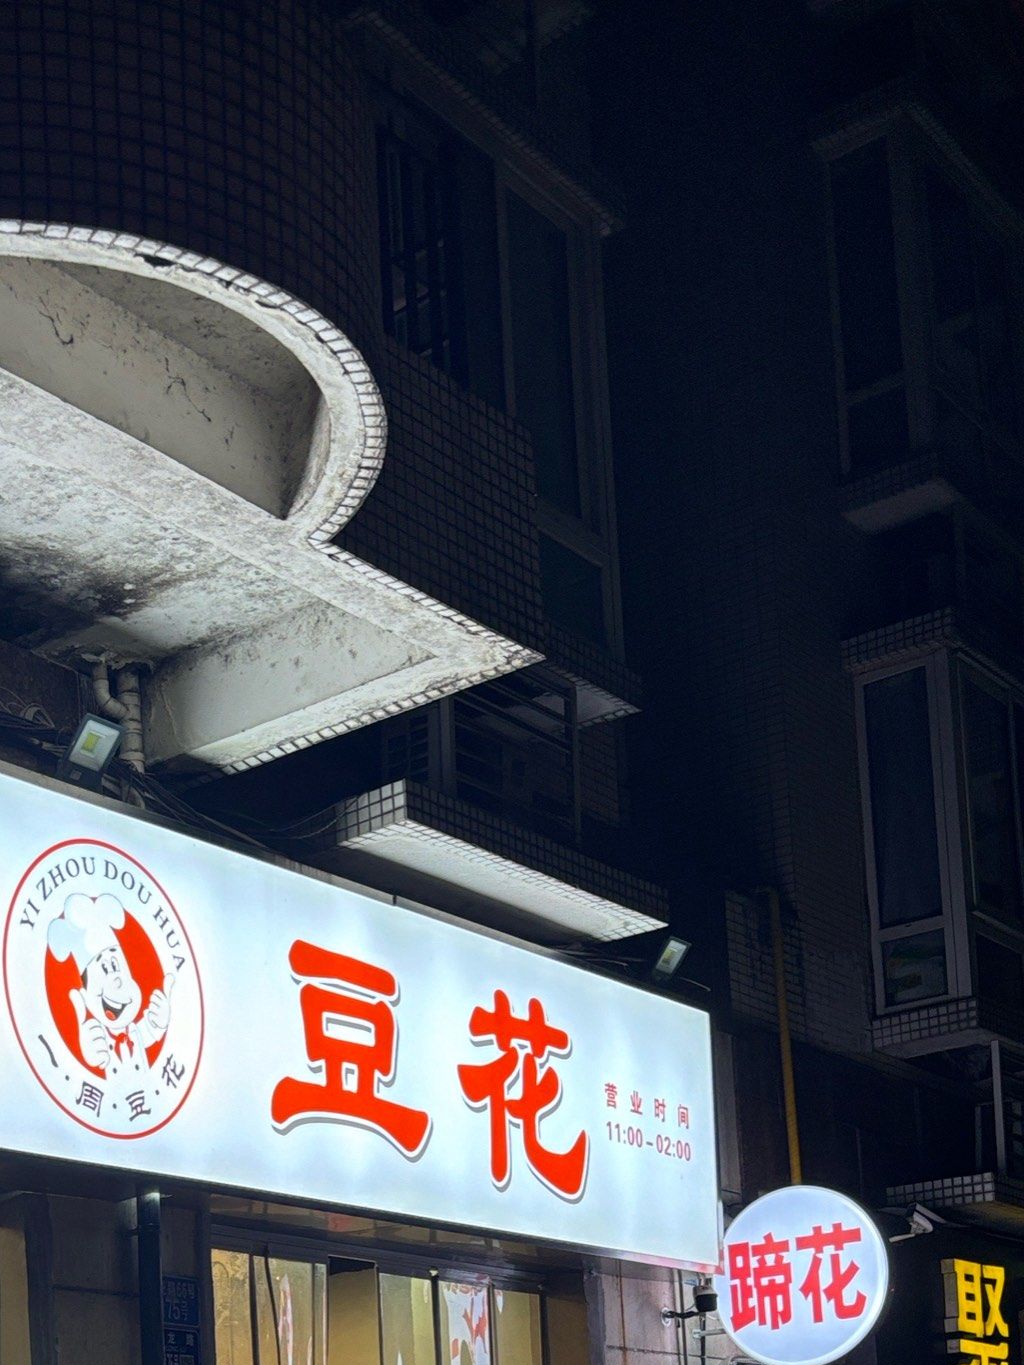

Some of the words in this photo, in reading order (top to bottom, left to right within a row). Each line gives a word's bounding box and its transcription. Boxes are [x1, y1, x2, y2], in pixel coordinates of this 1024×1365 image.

[20, 899, 41, 931] YI
[36, 856, 97, 900] ZHOU
[103, 859, 154, 906] DOU
[152, 906, 187, 973] HUA
[270, 938, 587, 1195] 豆花
[604, 1082, 690, 1130] 营业时间
[606, 1121, 692, 1162] 11:00-02:00
[727, 1222, 868, 1333] 蹄花
